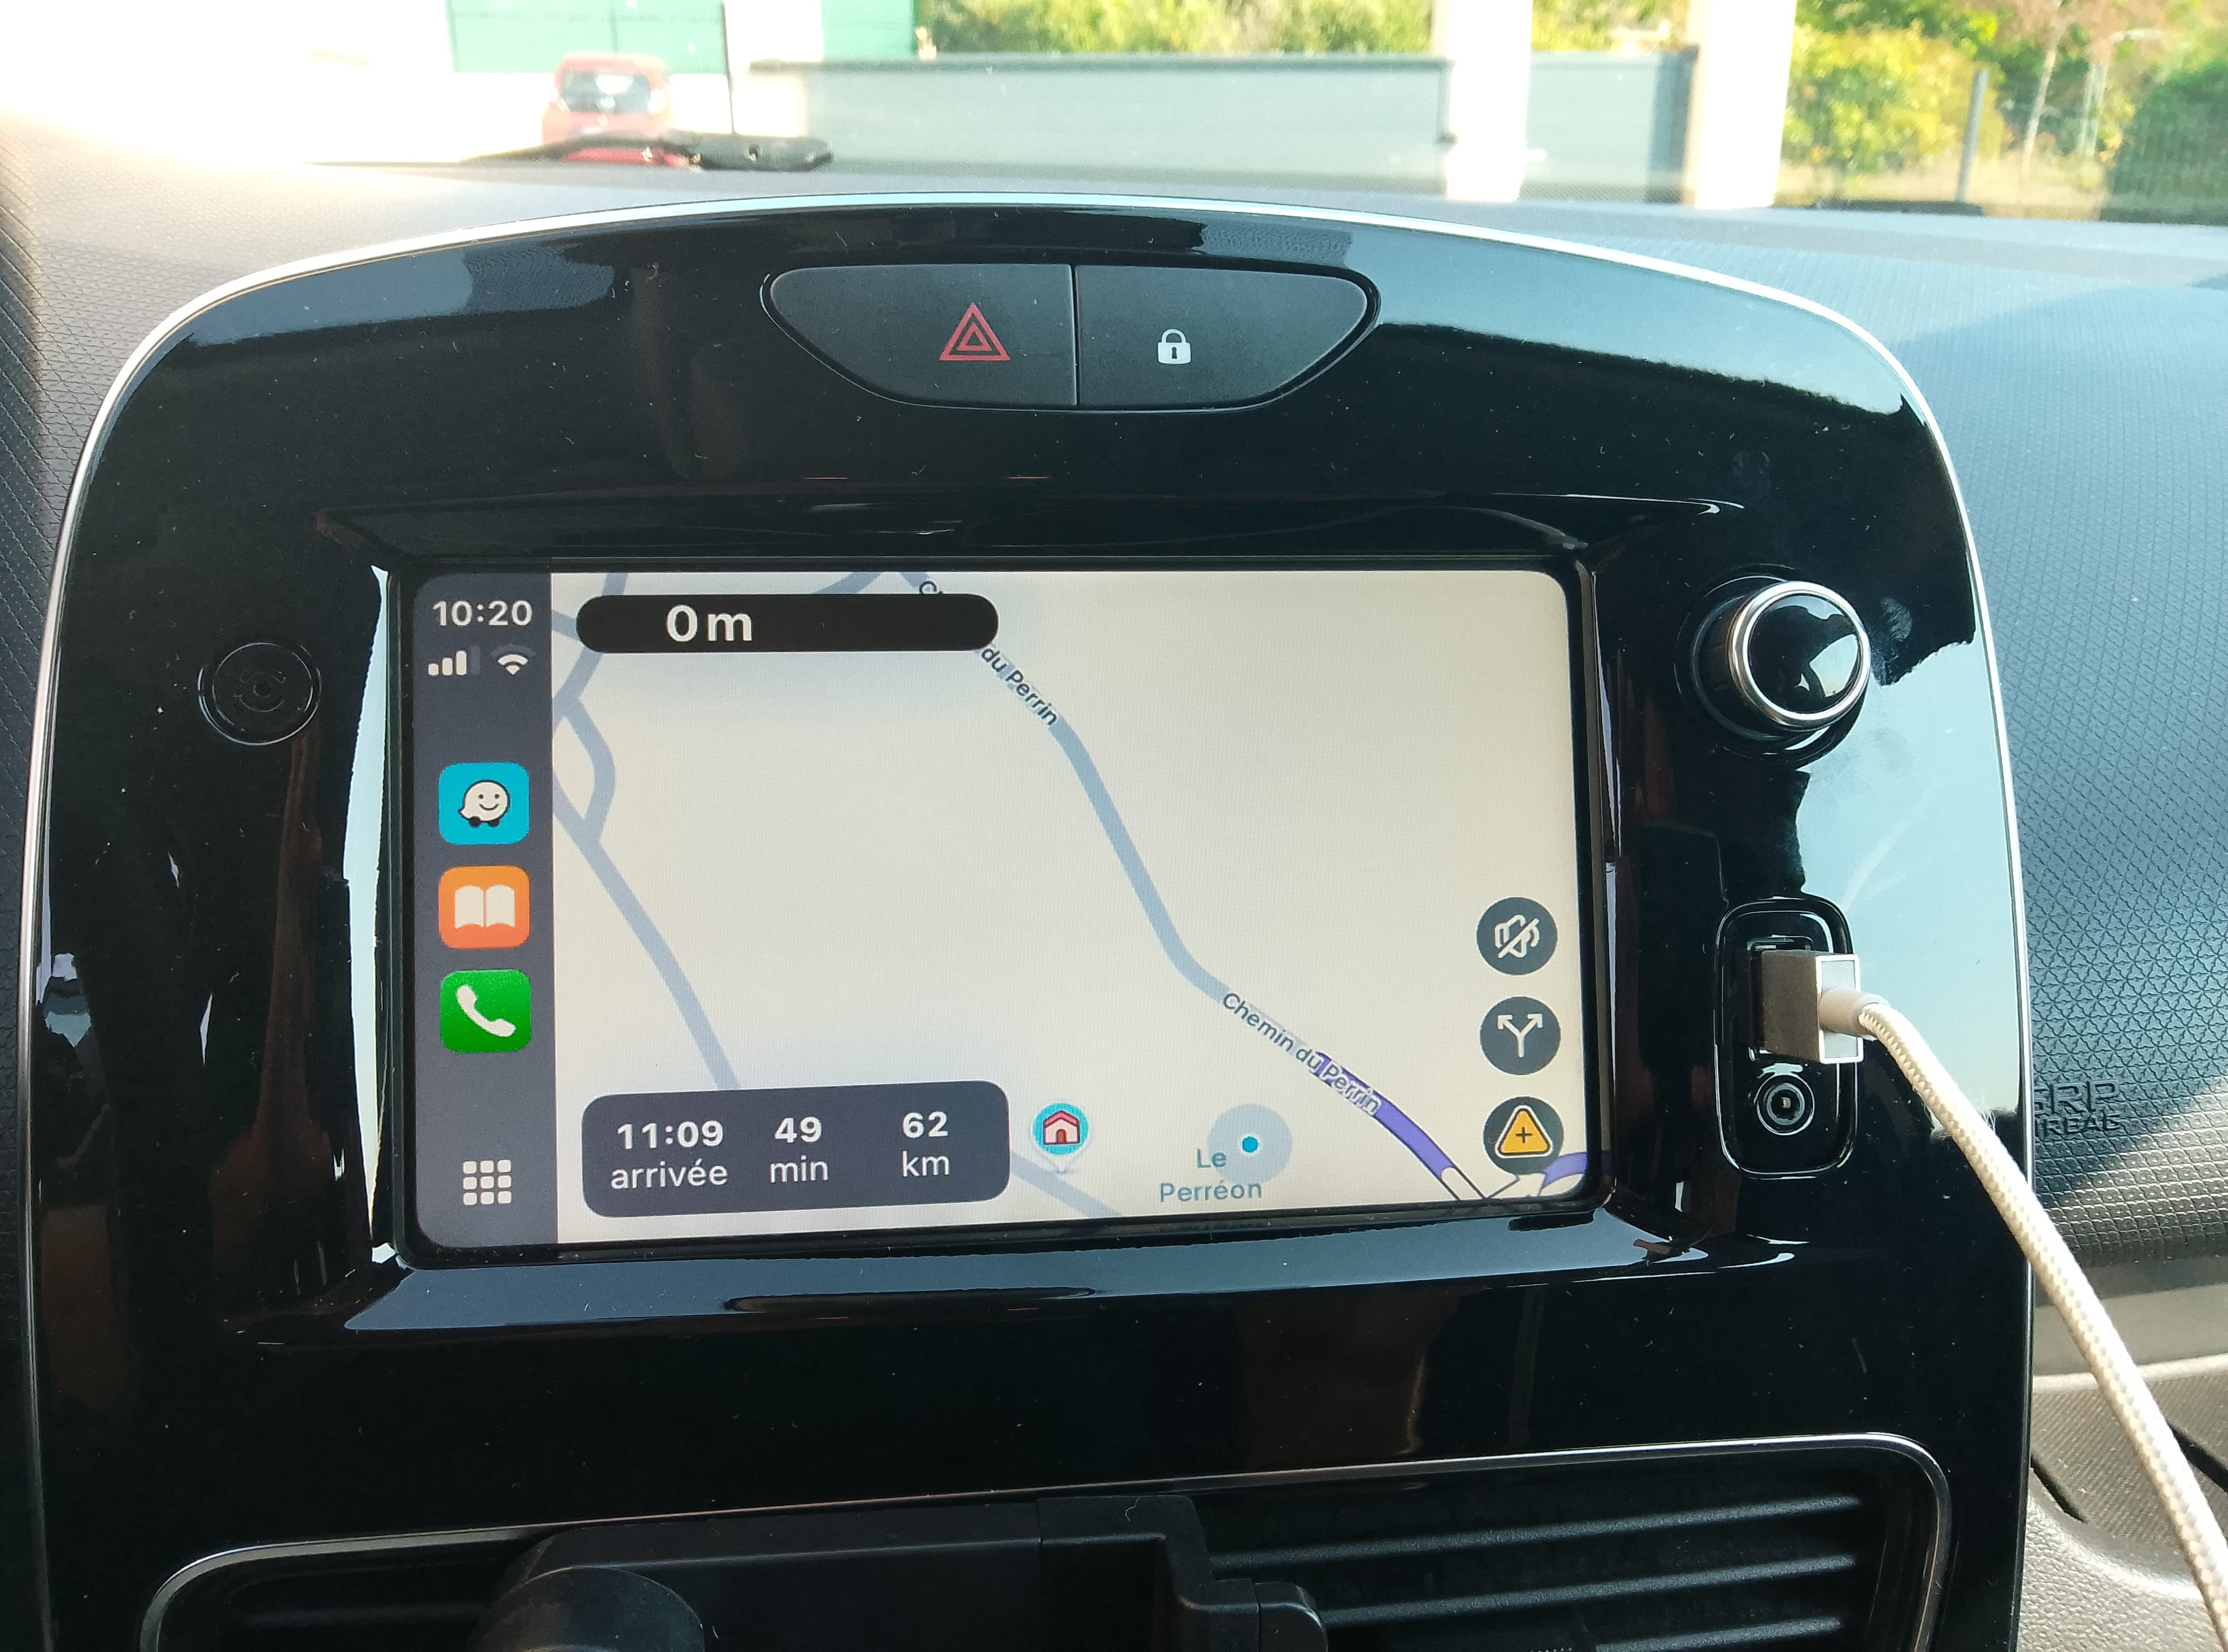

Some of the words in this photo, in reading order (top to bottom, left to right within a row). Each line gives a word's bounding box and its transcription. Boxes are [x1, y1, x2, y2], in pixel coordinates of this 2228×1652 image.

[433, 600, 533, 626] 10:20
[666, 605, 698, 642] 0
[707, 613, 753, 642] m
[981, 648, 1007, 672] du
[1005, 669, 1057, 726] Perrin
[1223, 993, 1295, 1052] Chemin
[1296, 1048, 1322, 1070] du
[1323, 1064, 1380, 1112] Perrin
[617, 1120, 724, 1150] 11:09
[774, 1116, 823, 1144] 49
[902, 1111, 949, 1138] 62
[770, 1155, 829, 1183] min
[902, 1150, 950, 1178] km
[1196, 1147, 1227, 1168] Le
[610, 1157, 728, 1189] arrivée
[1159, 1179, 1262, 1202] Perréon
